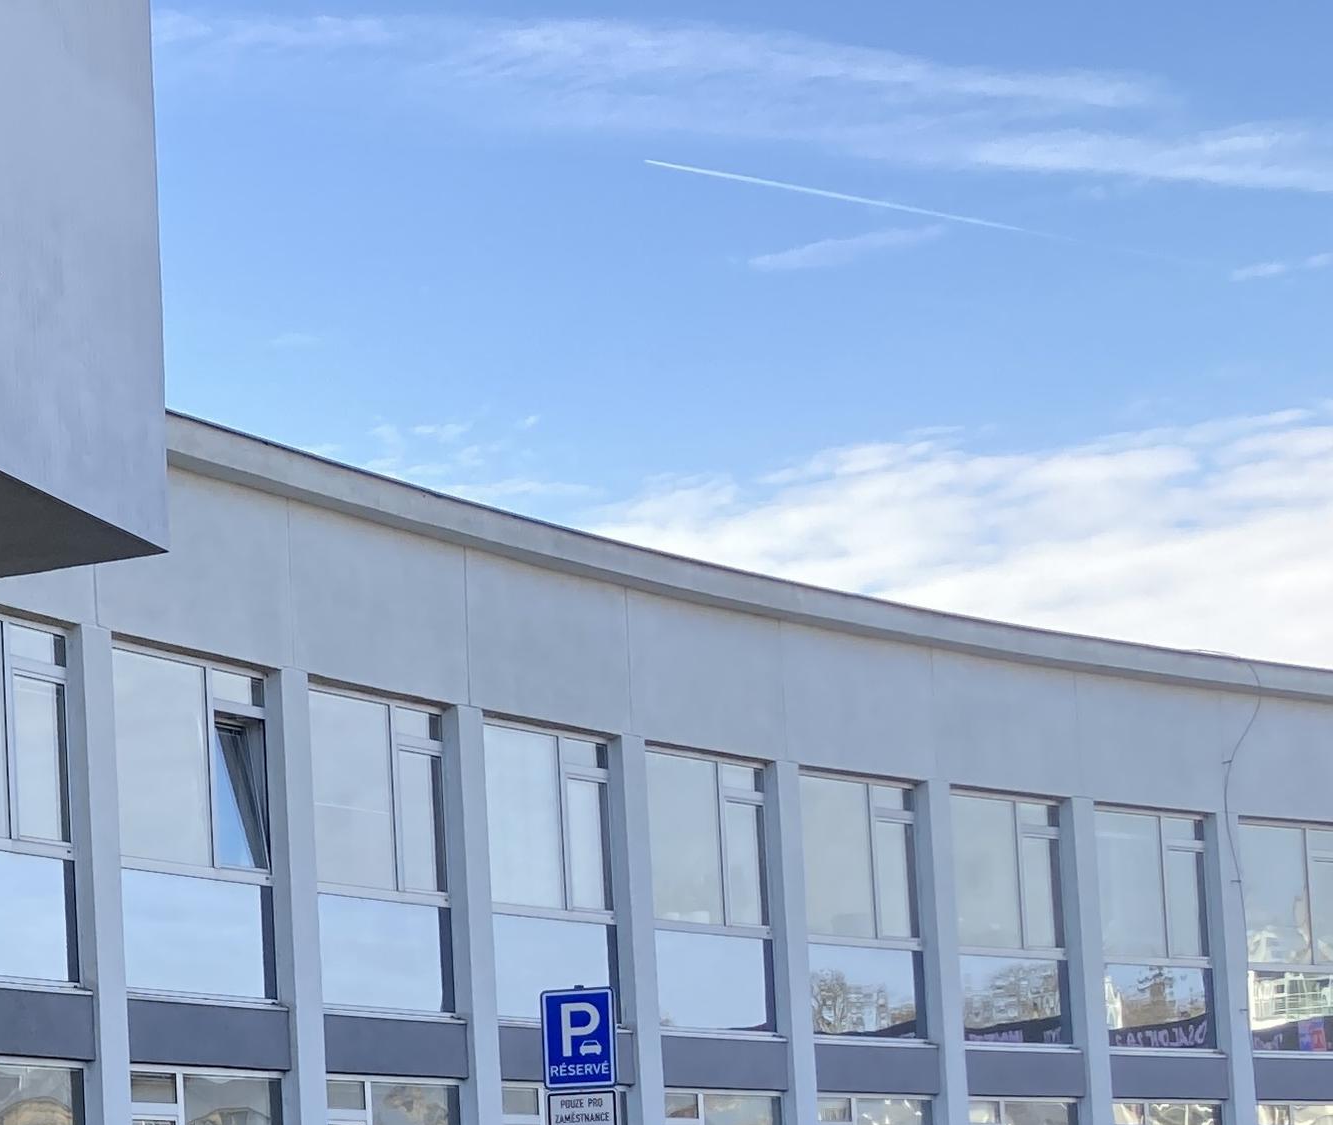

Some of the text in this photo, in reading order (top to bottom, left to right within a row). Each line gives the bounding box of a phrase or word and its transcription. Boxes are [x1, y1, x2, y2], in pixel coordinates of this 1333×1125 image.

[560, 1002, 600, 1057] P
[550, 1060, 609, 1077] RÉSERVÉ
[561, 1098, 603, 1109] POUZE PRO
